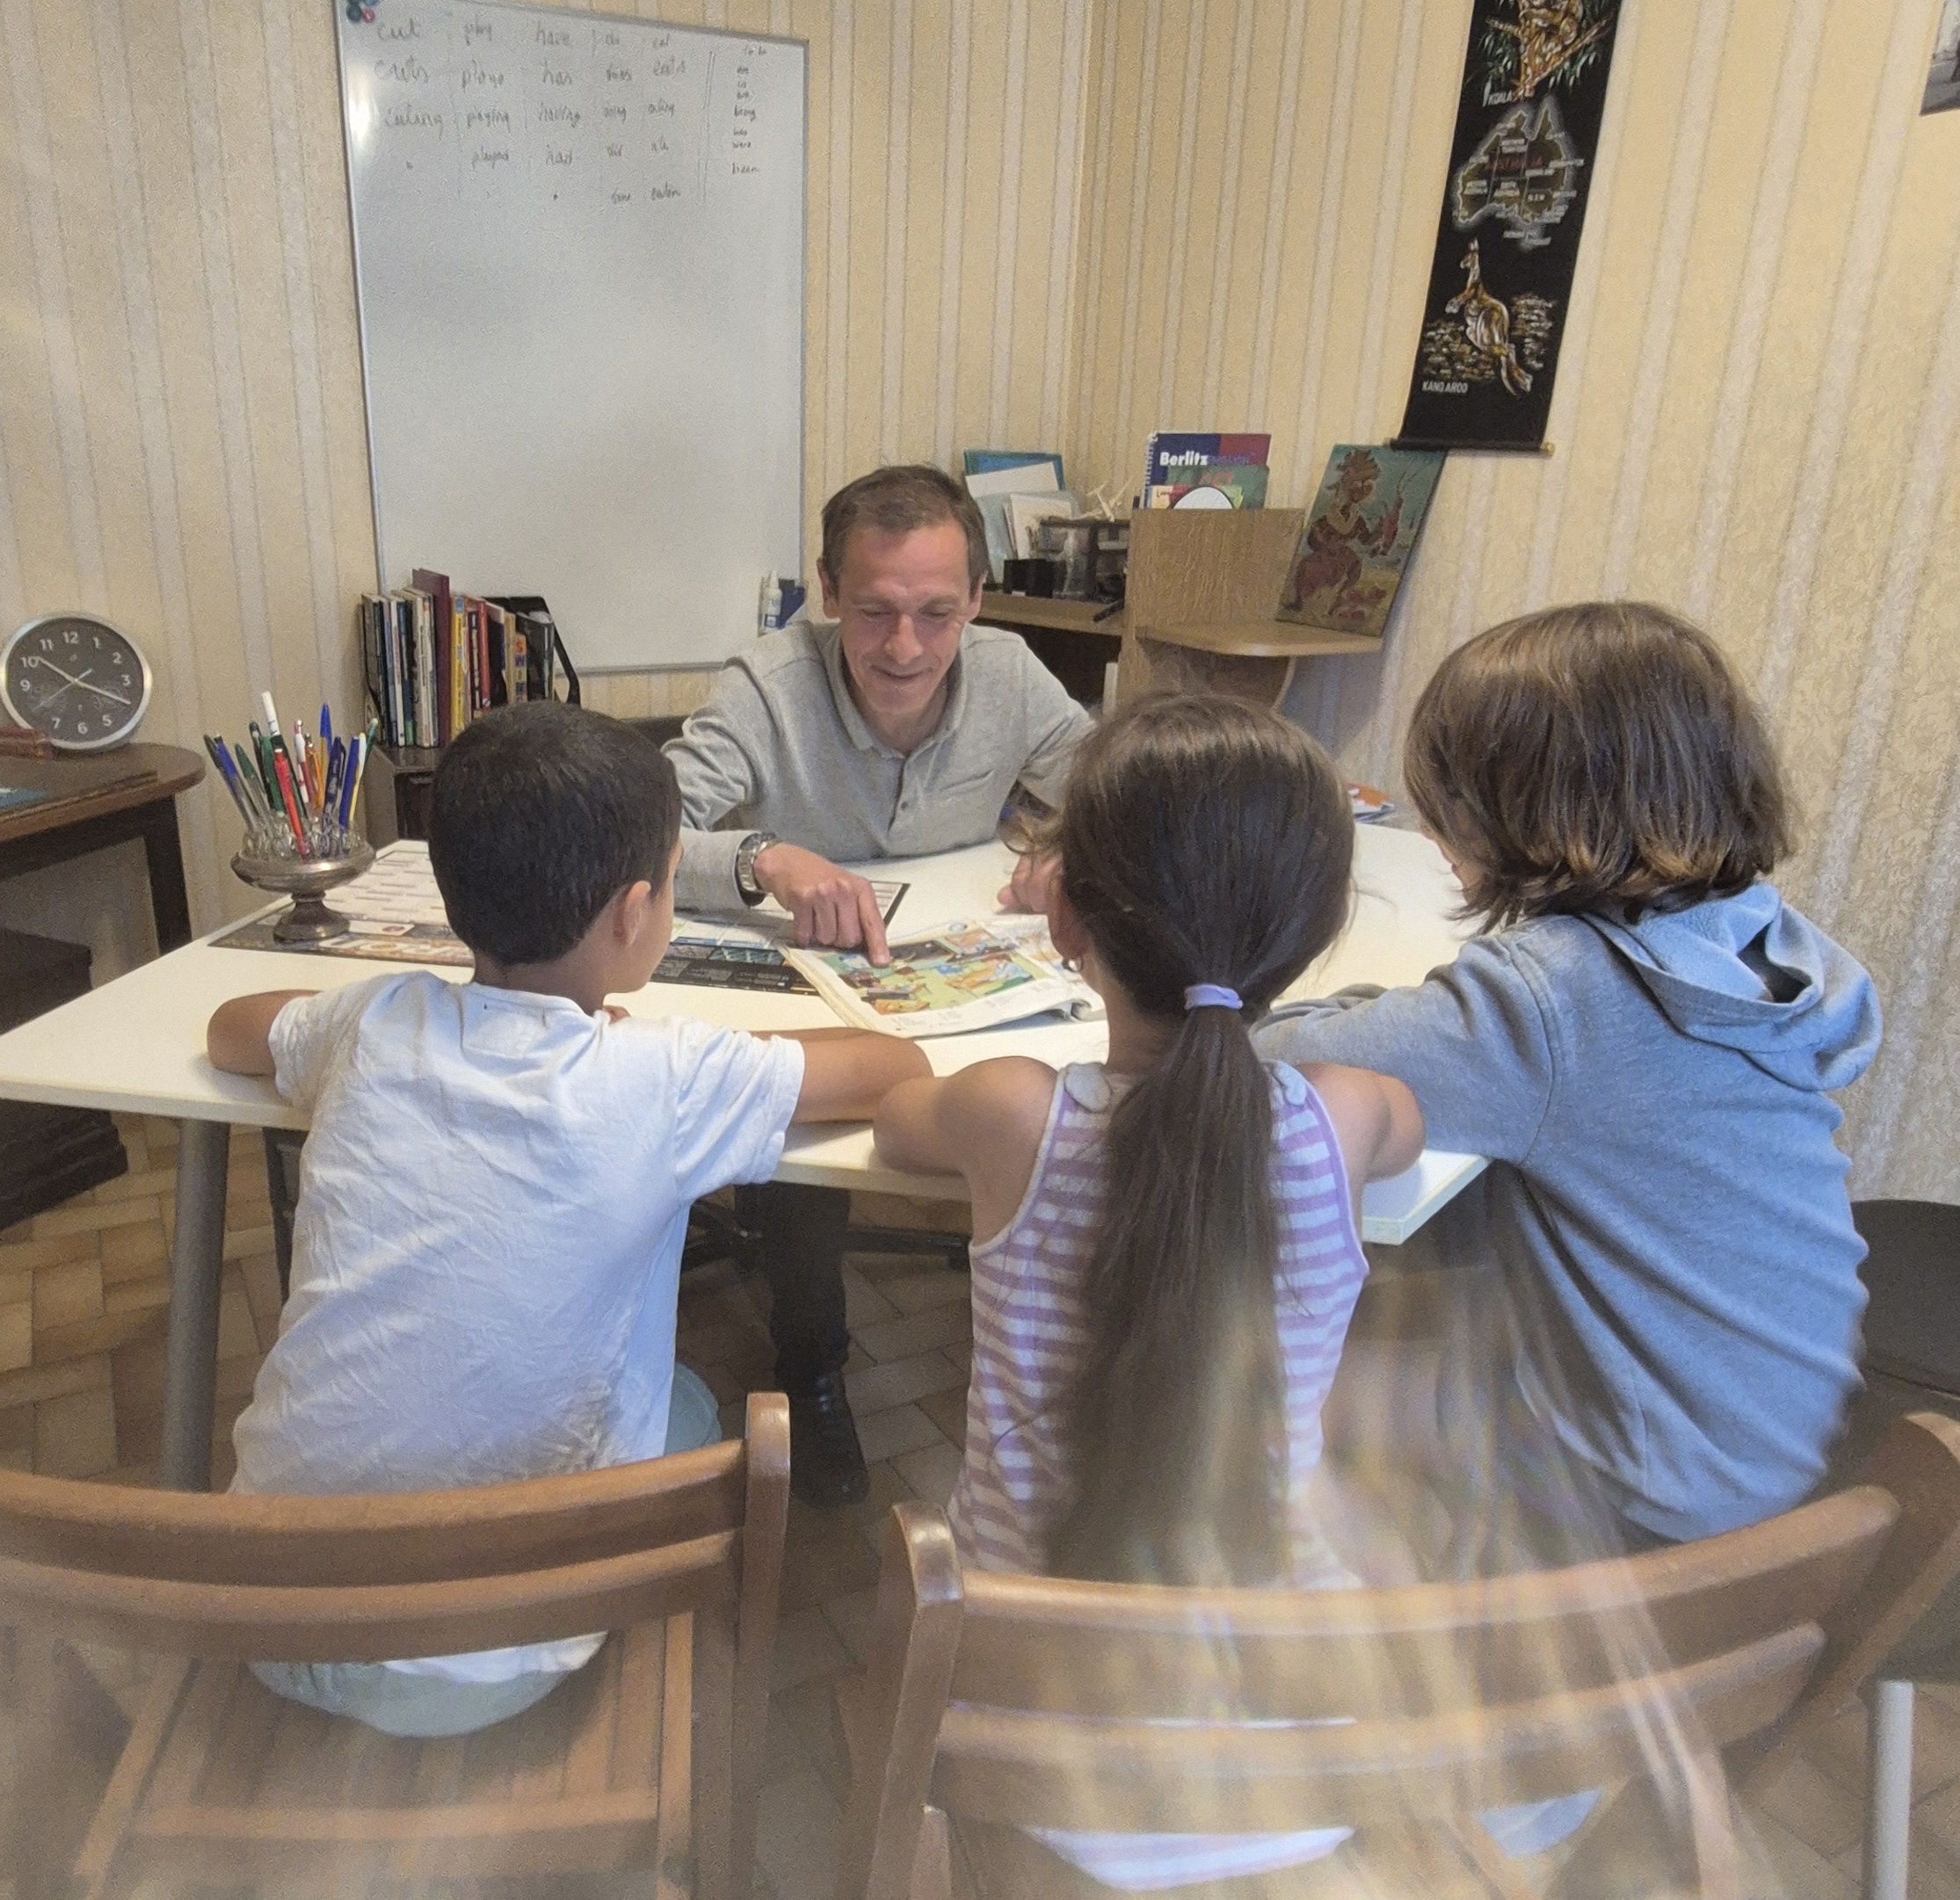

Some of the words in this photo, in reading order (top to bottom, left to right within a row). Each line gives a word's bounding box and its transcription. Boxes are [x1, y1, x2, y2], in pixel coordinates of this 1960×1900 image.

[1421, 380, 1469, 394] KANGAROO
[1159, 450, 1209, 467] Berlitz
[62, 631, 80, 644] 12
[92, 637, 101, 649] 1
[40, 639, 54, 651] 11
[20, 656, 40, 669] 10
[113, 652, 122, 664] 2
[19, 679, 31, 693] 9
[121, 674, 131, 687] 3
[51, 717, 62, 729] 7
[102, 714, 113, 728] 5
[77, 722, 89, 735] 6
